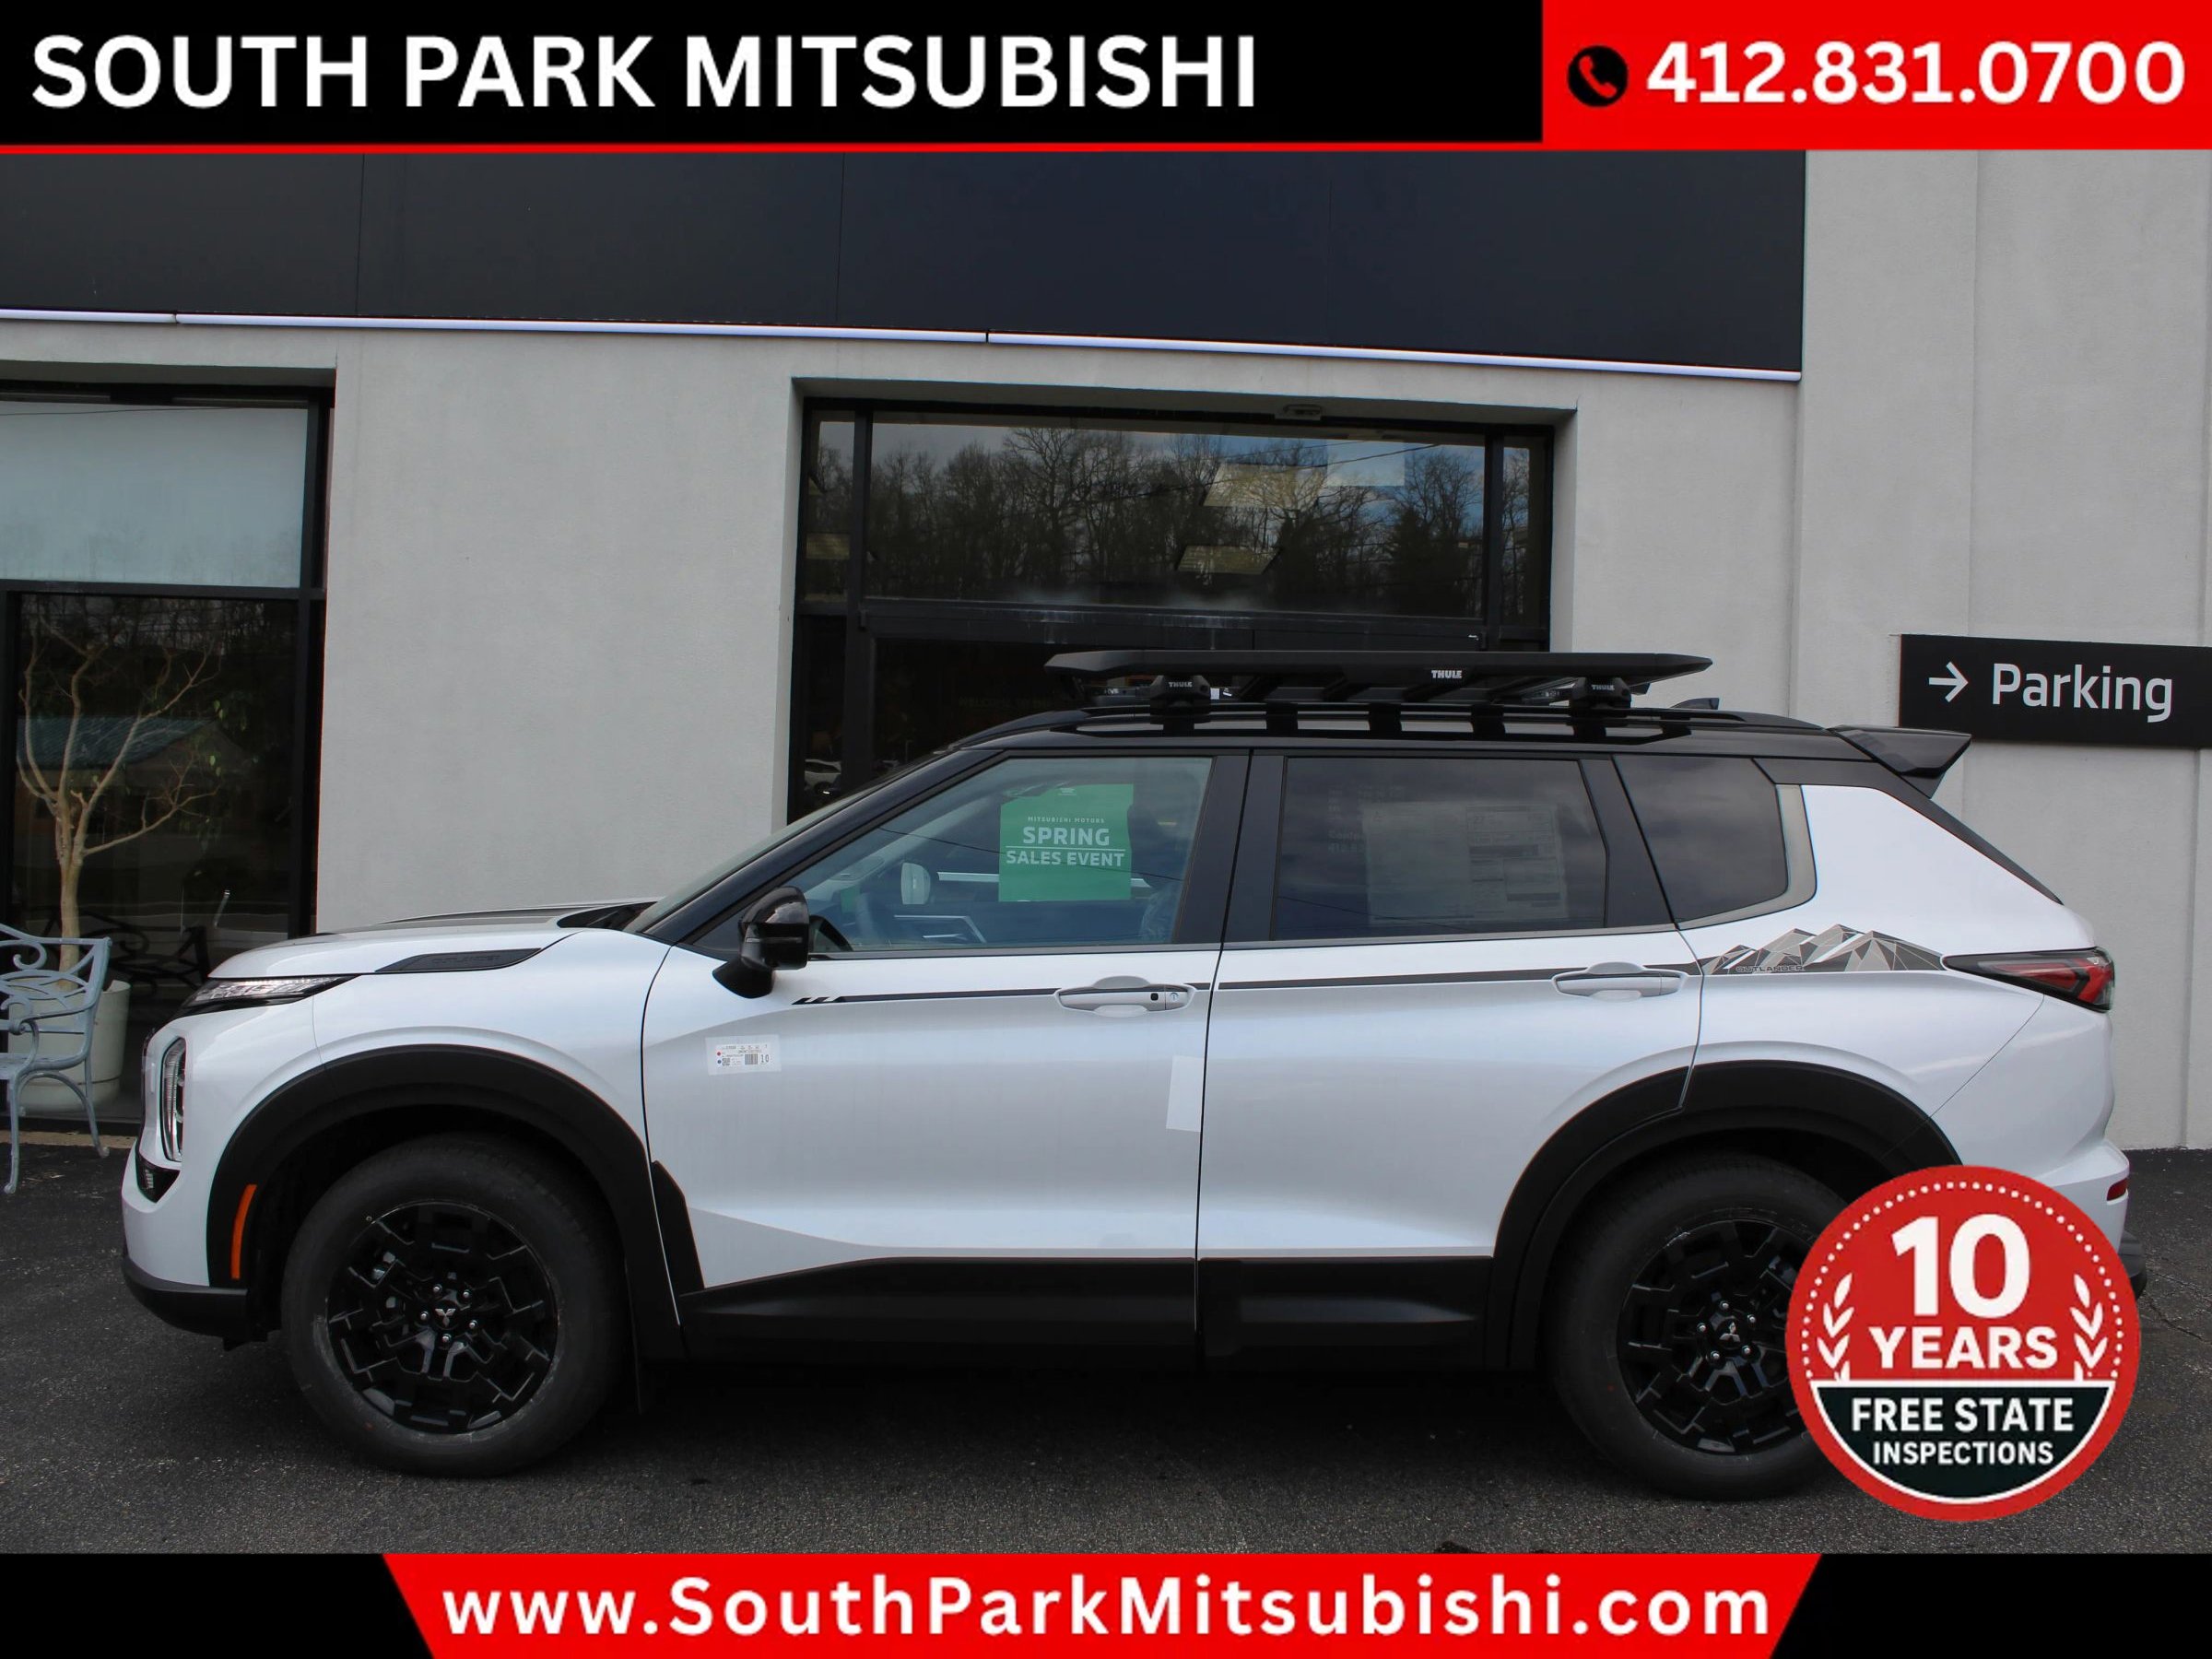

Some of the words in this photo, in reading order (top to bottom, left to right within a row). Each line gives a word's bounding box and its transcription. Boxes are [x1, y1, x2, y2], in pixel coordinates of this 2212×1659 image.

[1430, 669, 1463, 679] THULE
[1992, 663, 2173, 723] Parking
[1023, 826, 1110, 846] SPRING
[1006, 850, 1062, 865] SALES
[1066, 852, 1124, 866] EVENT
[1735, 965, 1806, 973] OUTLANDER
